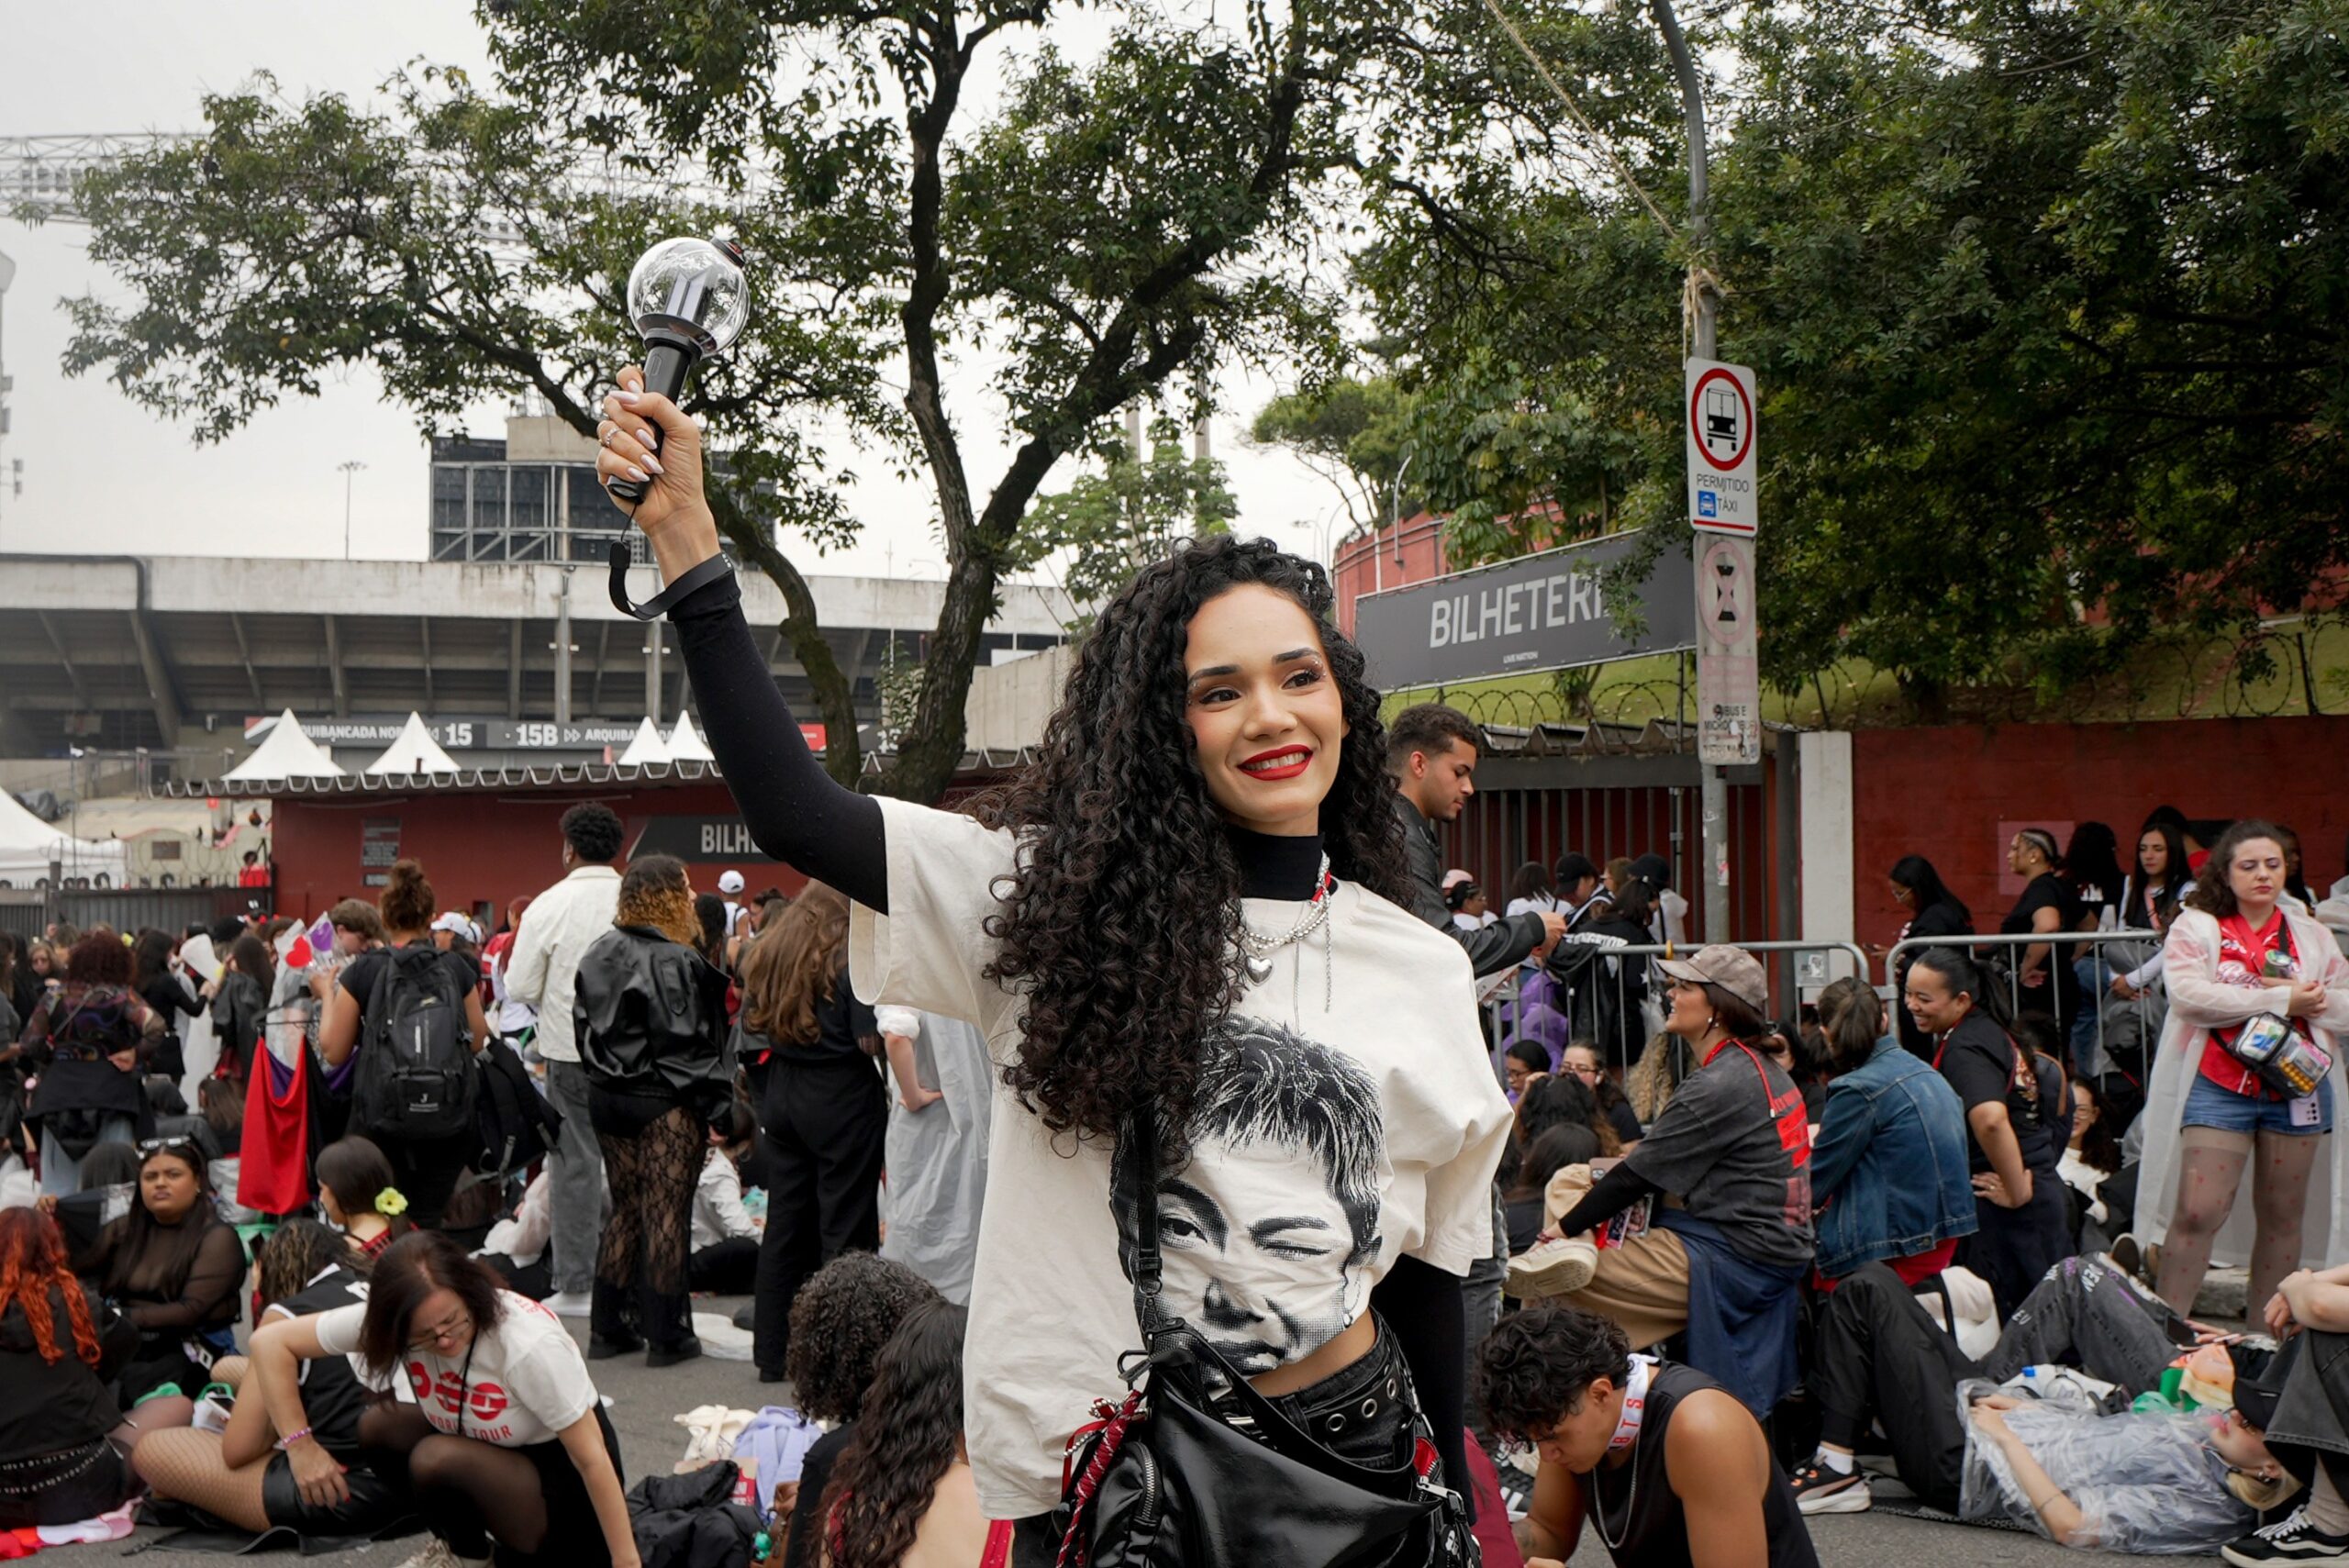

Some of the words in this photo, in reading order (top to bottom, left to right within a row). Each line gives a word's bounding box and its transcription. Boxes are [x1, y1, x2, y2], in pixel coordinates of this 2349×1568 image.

[1697, 473, 1749, 493] PERMITIDO
[1430, 567, 1608, 648] BILHETERI
[1503, 654, 1515, 663] LIVE
[1516, 651, 1539, 662] NATION
[444, 723, 472, 746] 15
[515, 723, 558, 747] 15B
[472, 1424, 512, 1442] TOUR
